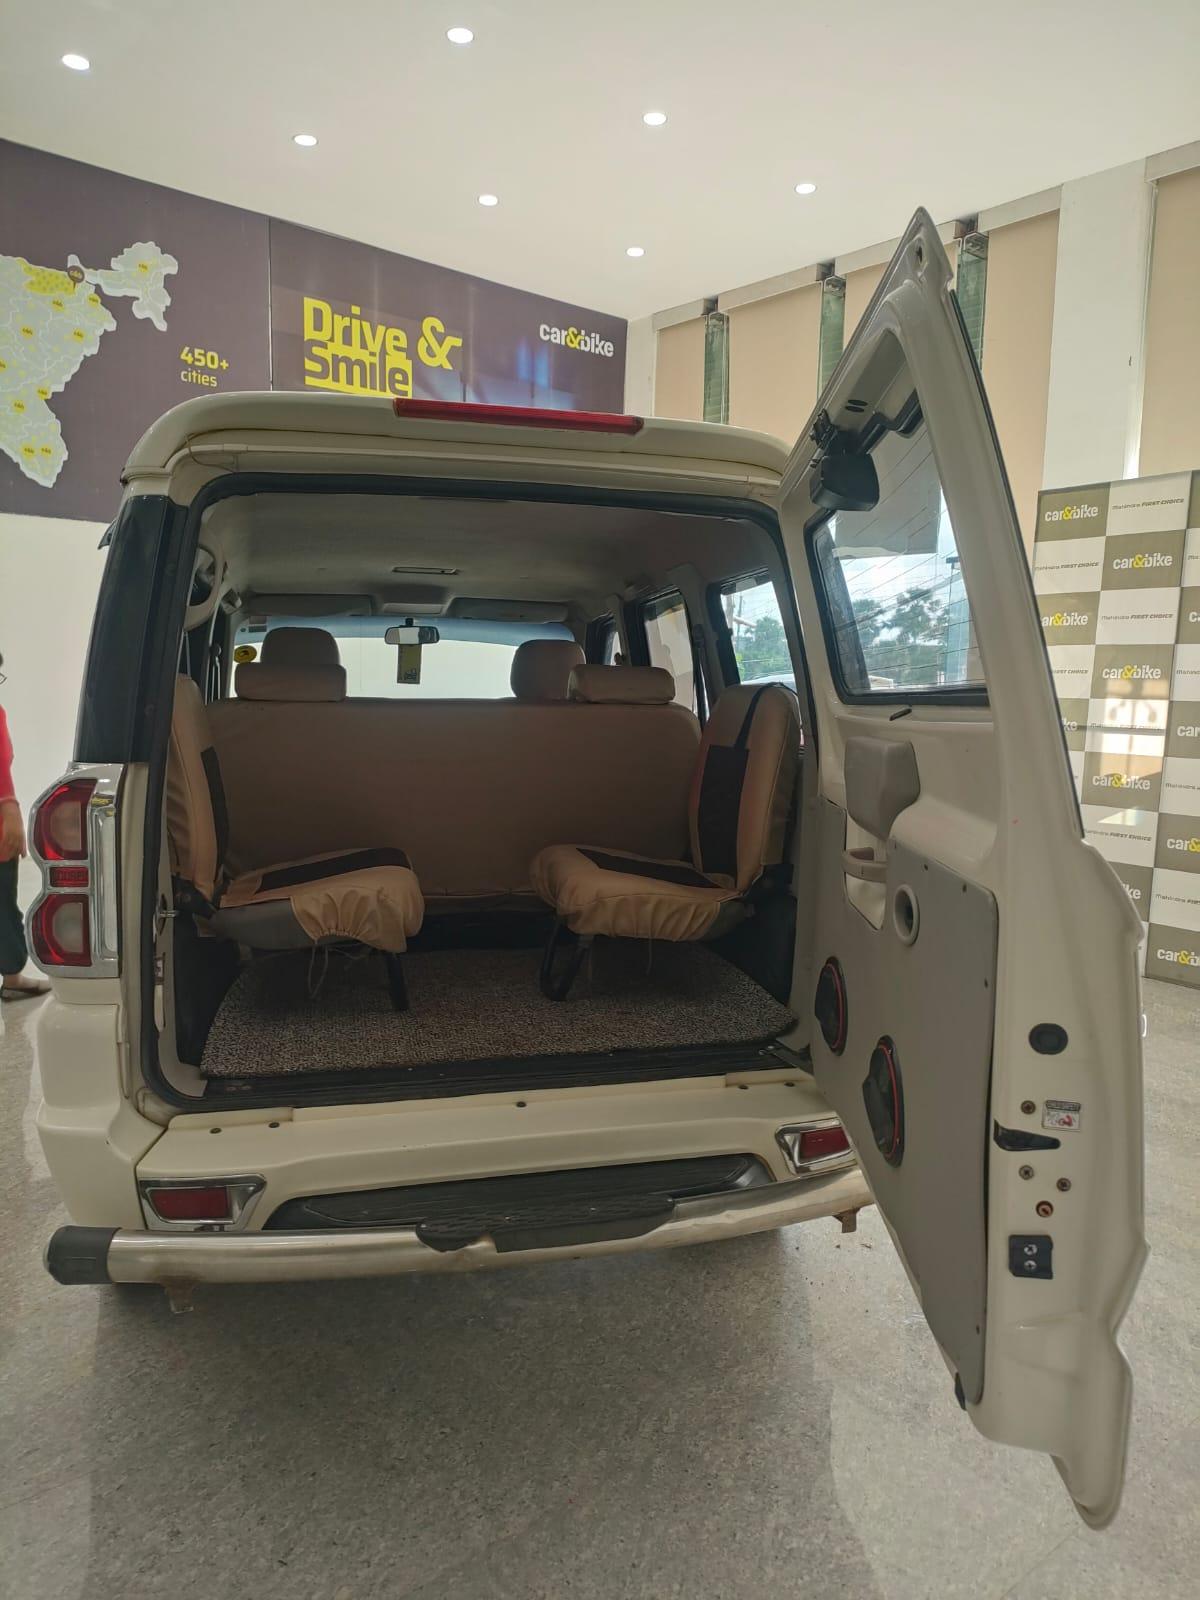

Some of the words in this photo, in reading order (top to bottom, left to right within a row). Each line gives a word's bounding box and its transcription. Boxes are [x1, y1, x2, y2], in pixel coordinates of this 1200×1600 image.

[303, 296, 408, 356] Drive
[417, 316, 463, 370] &
[539, 323, 614, 357] car&bike
[180, 346, 229, 370] 450+
[304, 339, 410, 397] Smile
[180, 367, 218, 387] cities
[1044, 504, 1099, 522] car&bike
[1112, 553, 1173, 569] car&bike
[1102, 665, 1162, 680] car&bike
[1092, 773, 1151, 791] car&bike
